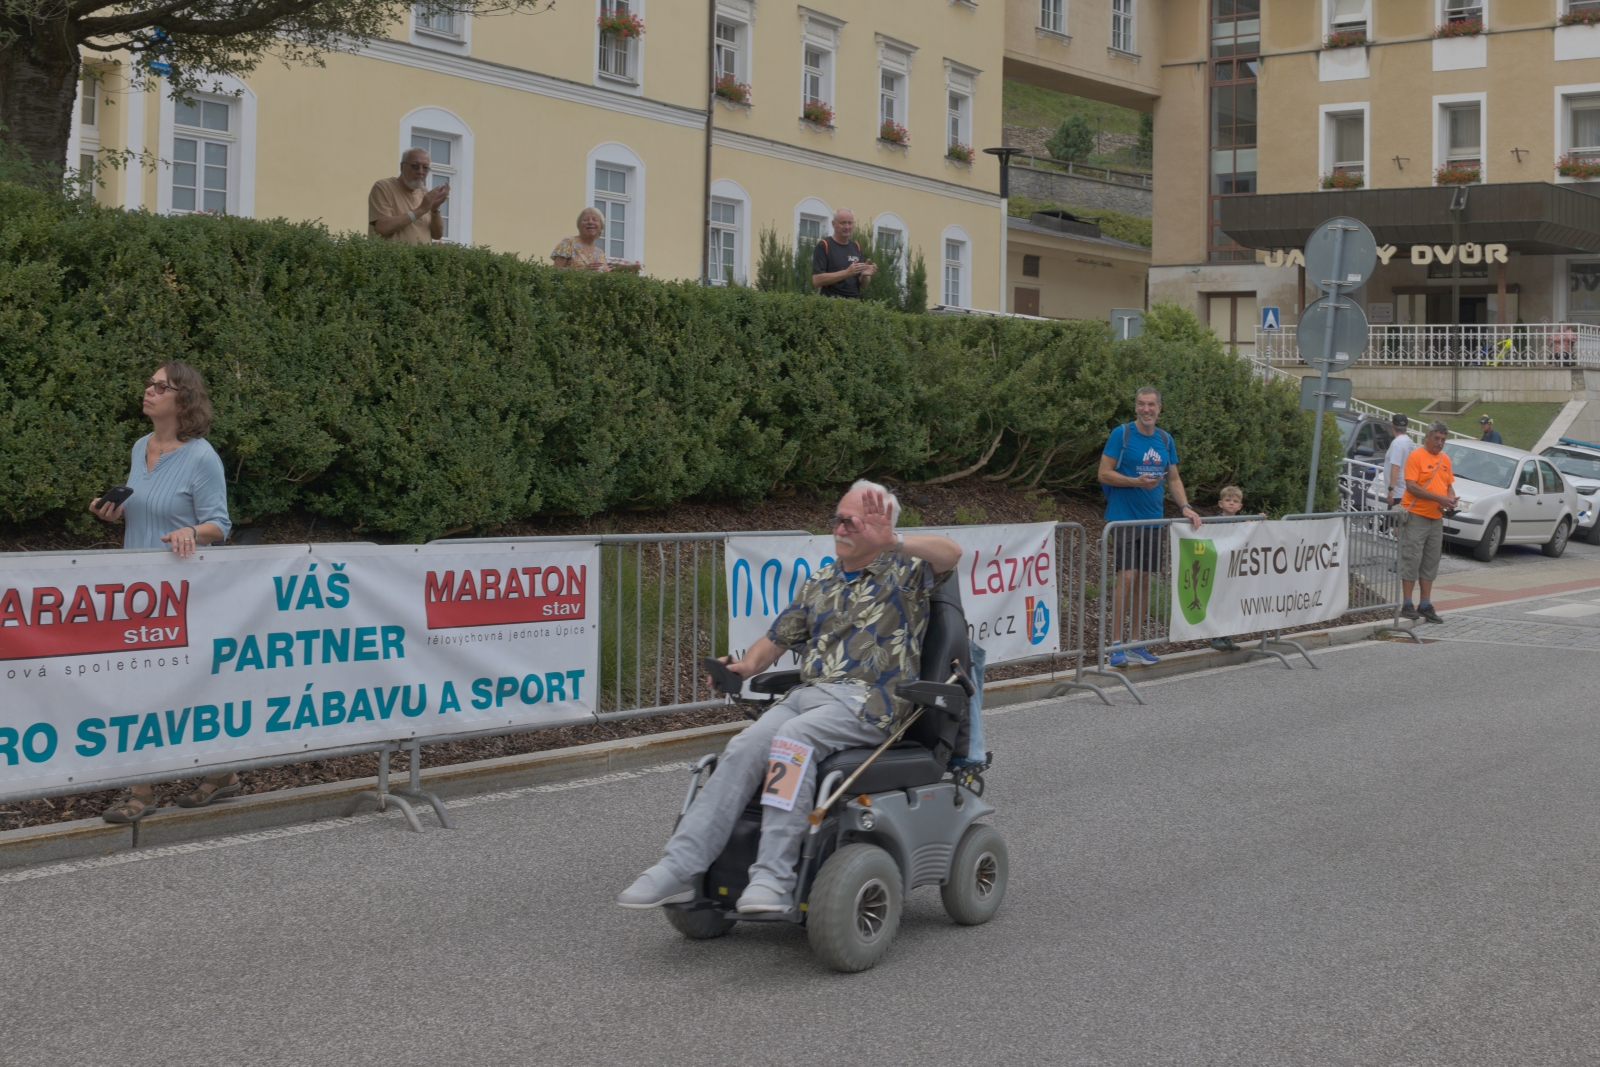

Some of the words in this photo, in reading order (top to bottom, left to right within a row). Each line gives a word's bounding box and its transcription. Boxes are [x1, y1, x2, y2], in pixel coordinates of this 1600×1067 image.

[1411, 242, 1508, 265] DVŮR
[1227, 541, 1288, 578] MĚSTO
[1294, 538, 1340, 572] ÚPICE
[272, 563, 350, 611] VÁŠ
[425, 565, 586, 603] MARATON
[542, 601, 581, 616] stav
[1240, 590, 1323, 617] www.upice.cz
[123, 625, 180, 644] stav
[508, 628, 550, 641] jednota
[556, 624, 585, 637] Úpice
[211, 625, 405, 675] PARTNER
[65, 654, 190, 677] společnost
[75, 700, 252, 757] STAVBU
[265, 682, 427, 733] ZÁBAVU
[438, 680, 462, 715] A
[471, 669, 585, 710] SPORT
[765, 761, 787, 795] 2
